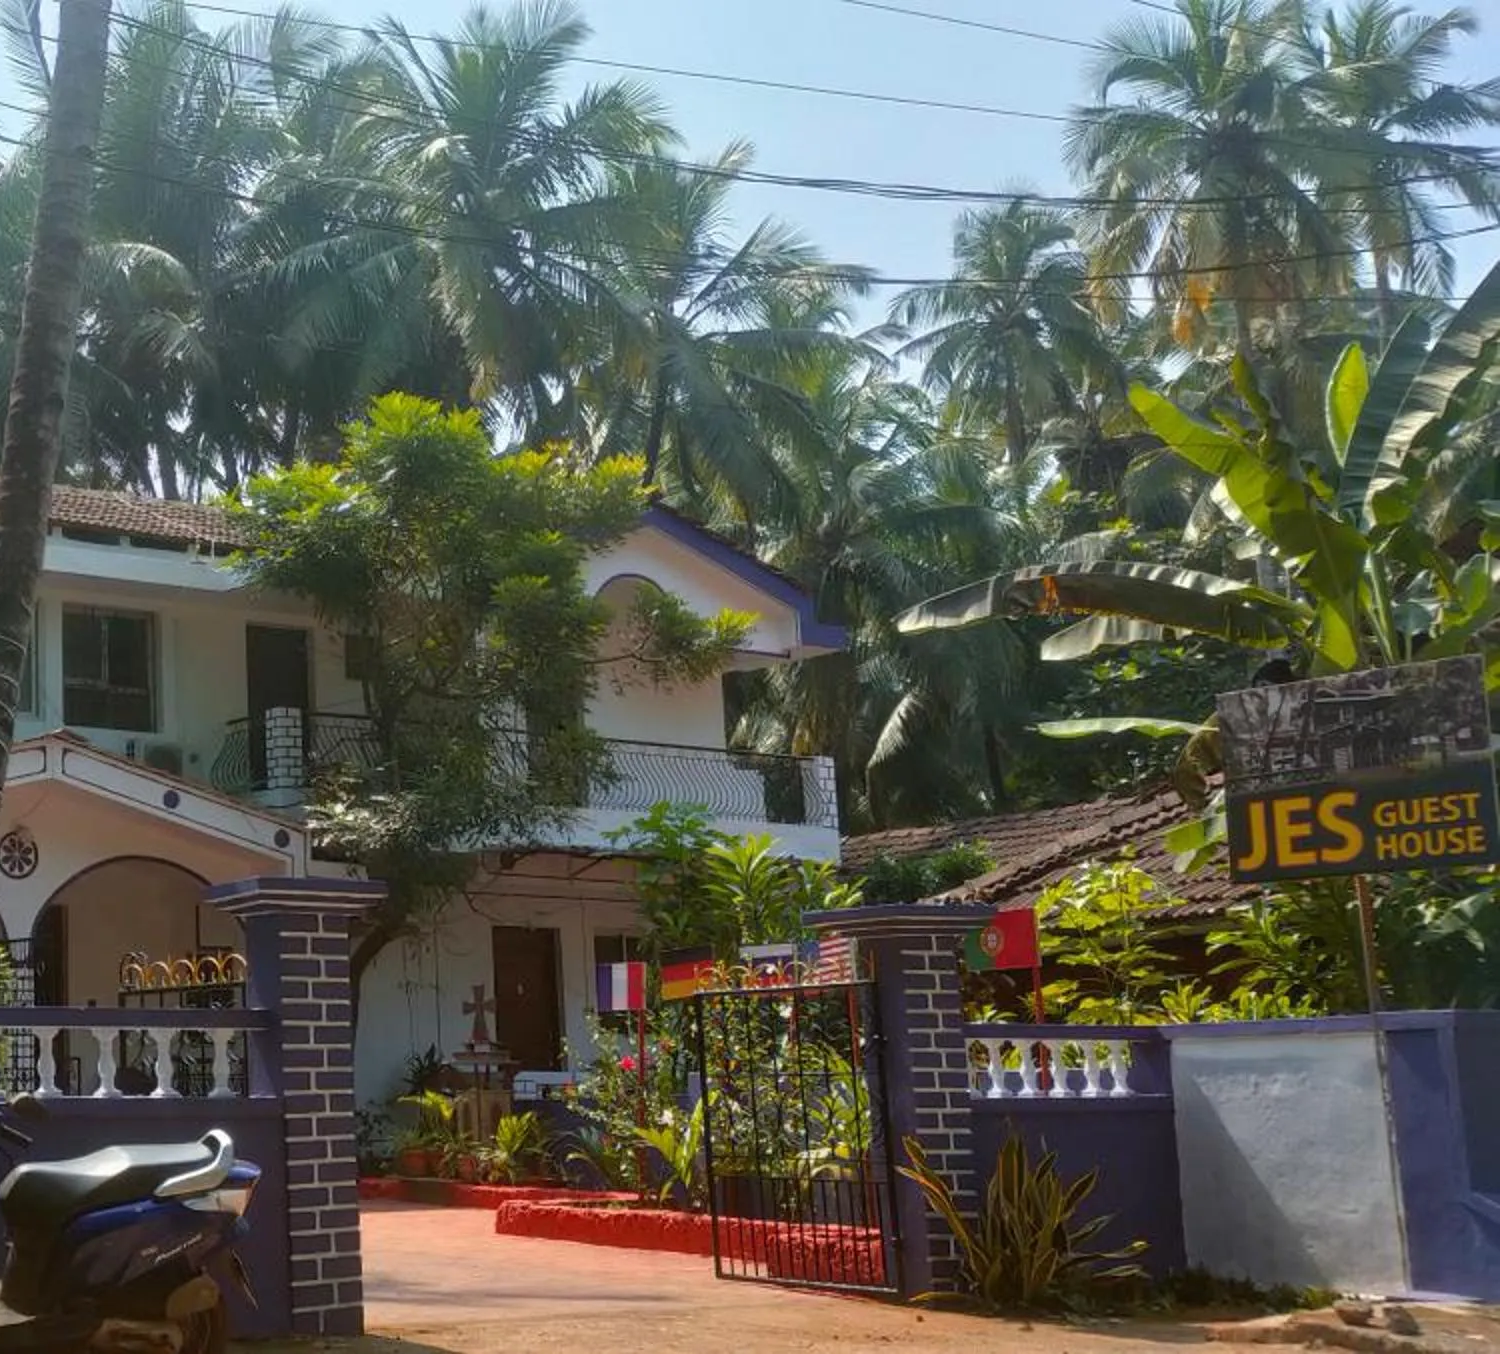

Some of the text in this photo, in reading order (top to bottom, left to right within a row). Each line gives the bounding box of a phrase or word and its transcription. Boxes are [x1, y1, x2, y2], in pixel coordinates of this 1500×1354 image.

[1374, 793, 1481, 827] GUEST
[1238, 792, 1363, 872] JES
[1376, 827, 1487, 861] HOUSE
